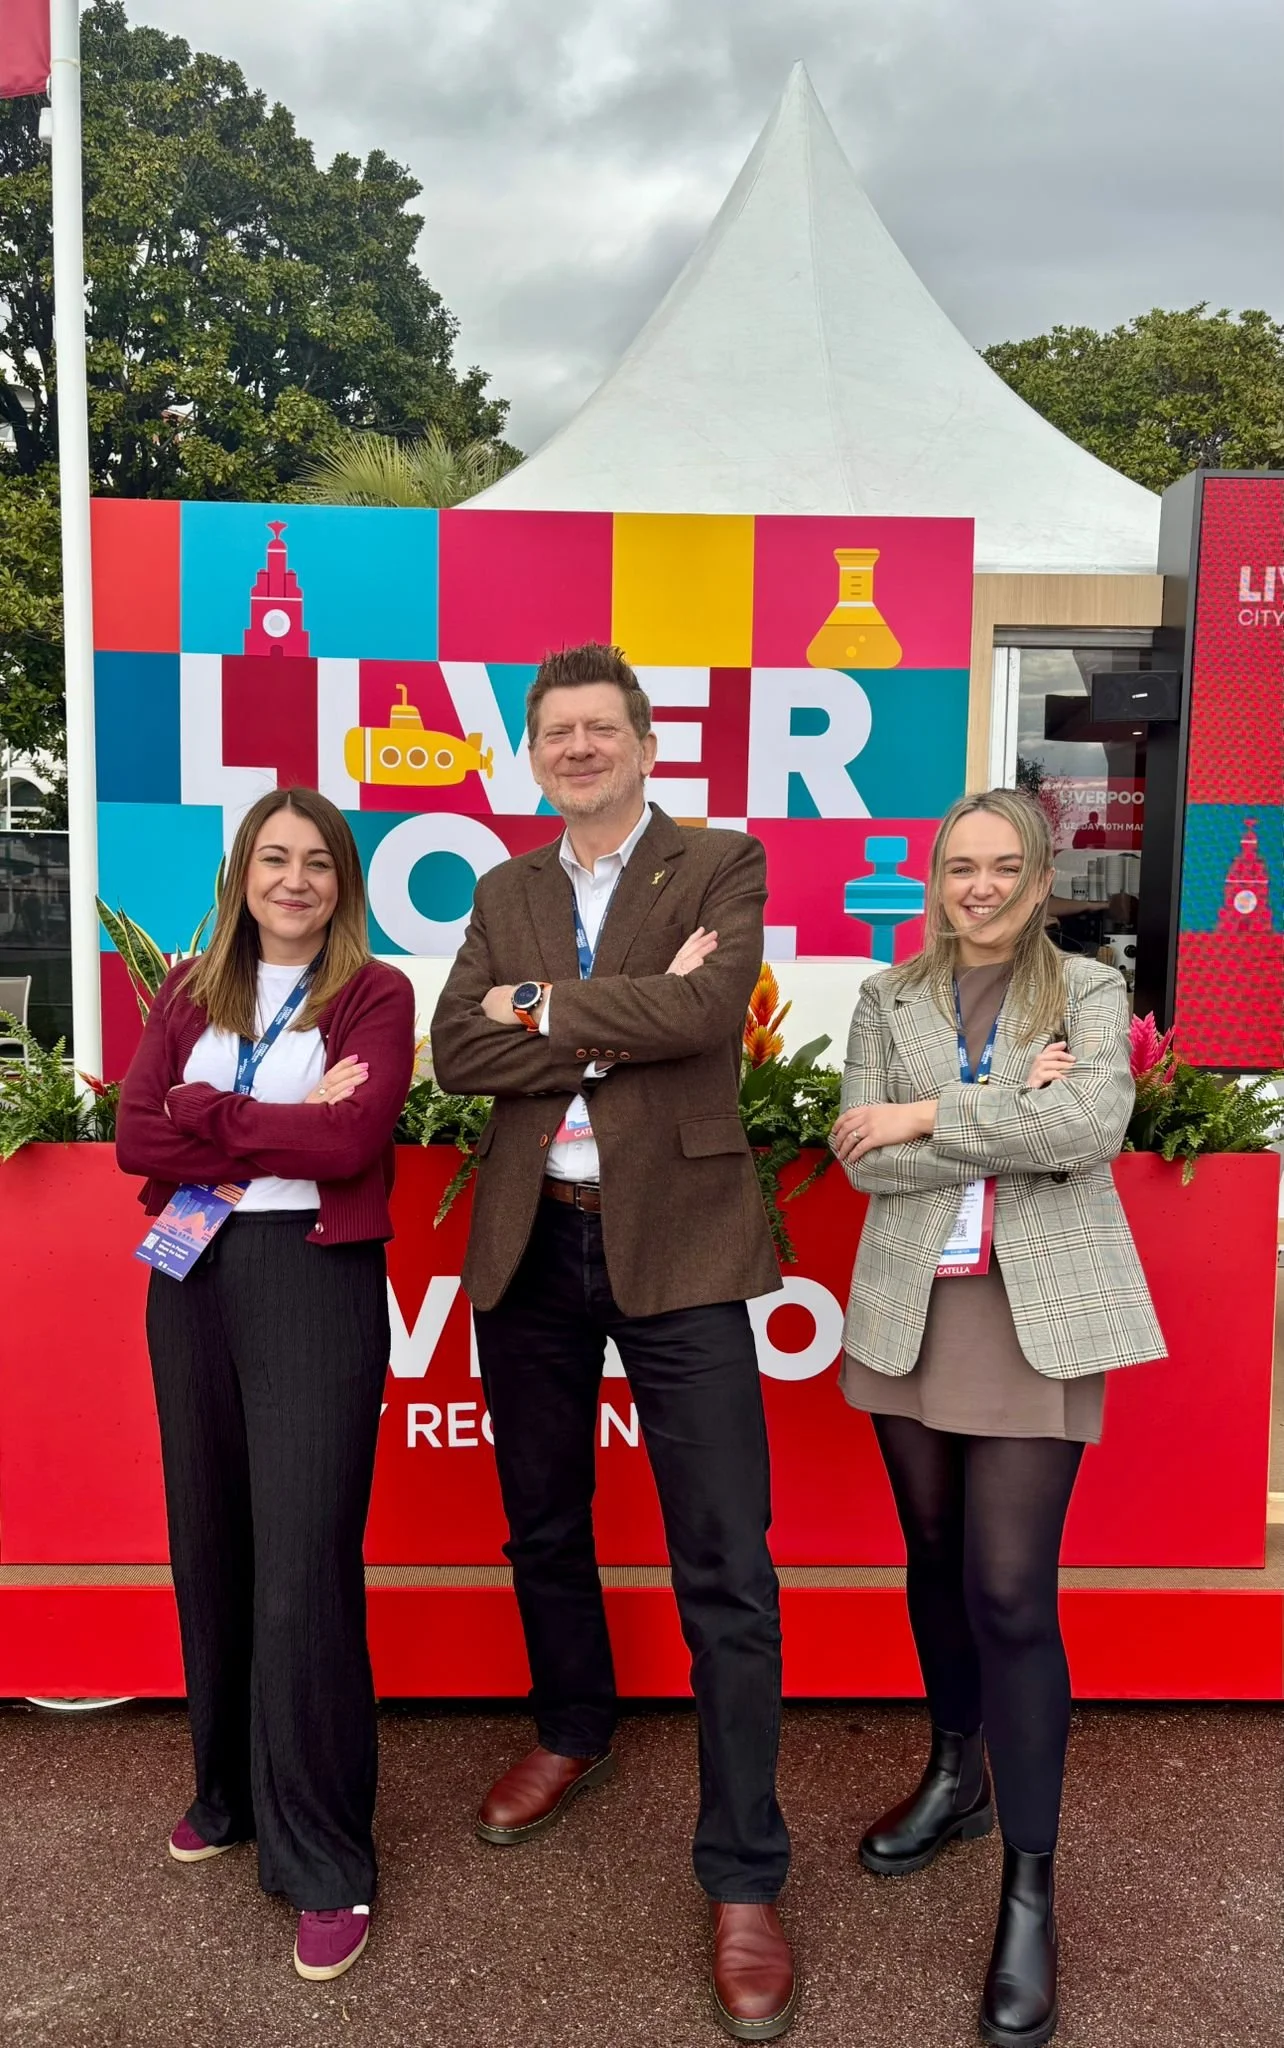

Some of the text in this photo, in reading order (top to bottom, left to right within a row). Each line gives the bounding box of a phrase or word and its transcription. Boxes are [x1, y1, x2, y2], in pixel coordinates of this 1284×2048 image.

[1238, 565, 1284, 602] LI
[1237, 608, 1284, 626] CITY
[180, 652, 873, 819] LIVER
[937, 1265, 970, 1275] CATELLA
